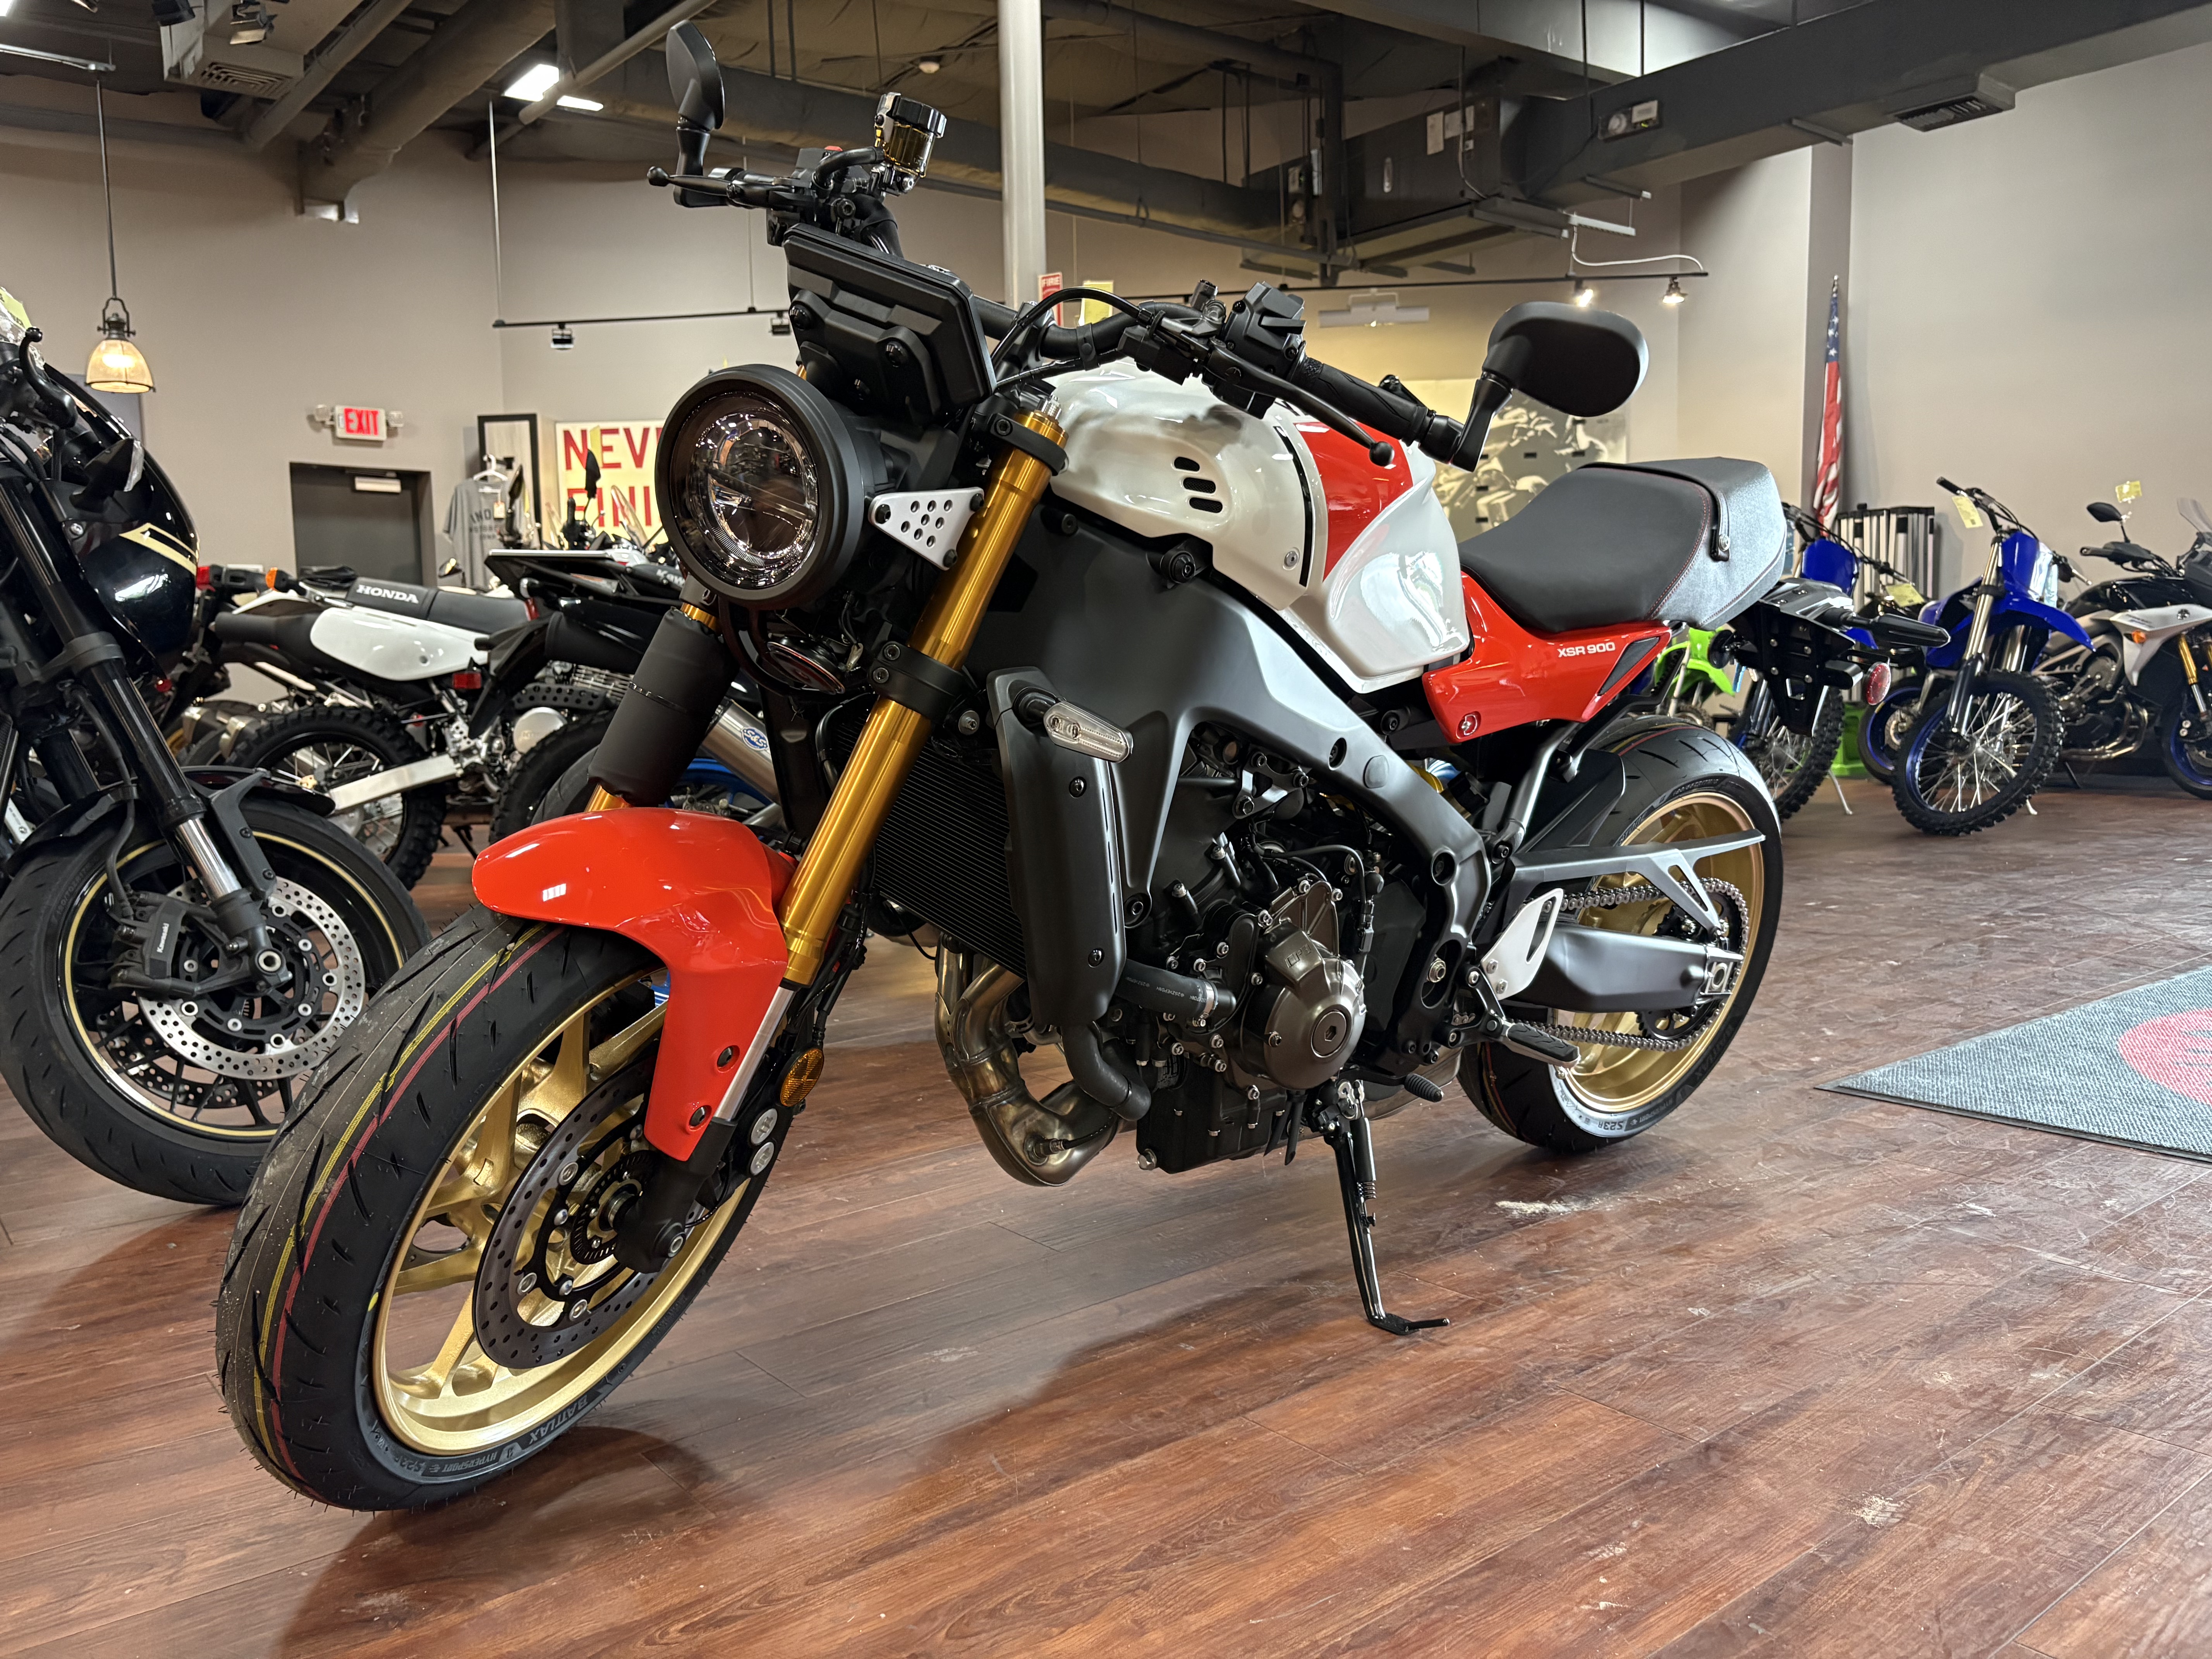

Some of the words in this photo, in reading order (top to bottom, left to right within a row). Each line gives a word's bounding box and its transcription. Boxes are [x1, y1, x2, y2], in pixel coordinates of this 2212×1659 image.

[344, 408, 379, 436] EXIT
[563, 427, 663, 470] NEV
[567, 486, 661, 527] FINI
[356, 584, 419, 604] HONDA
[1557, 646, 1586, 658] XSR
[1587, 642, 1616, 654] 900
[744, 730, 766, 747] S&S
[156, 922, 169, 953] Kawasaki
[1598, 1120, 1624, 1130] S23R
[528, 1394, 588, 1445] BATTLAX
[441, 1452, 497, 1473] HYPERSPORT
